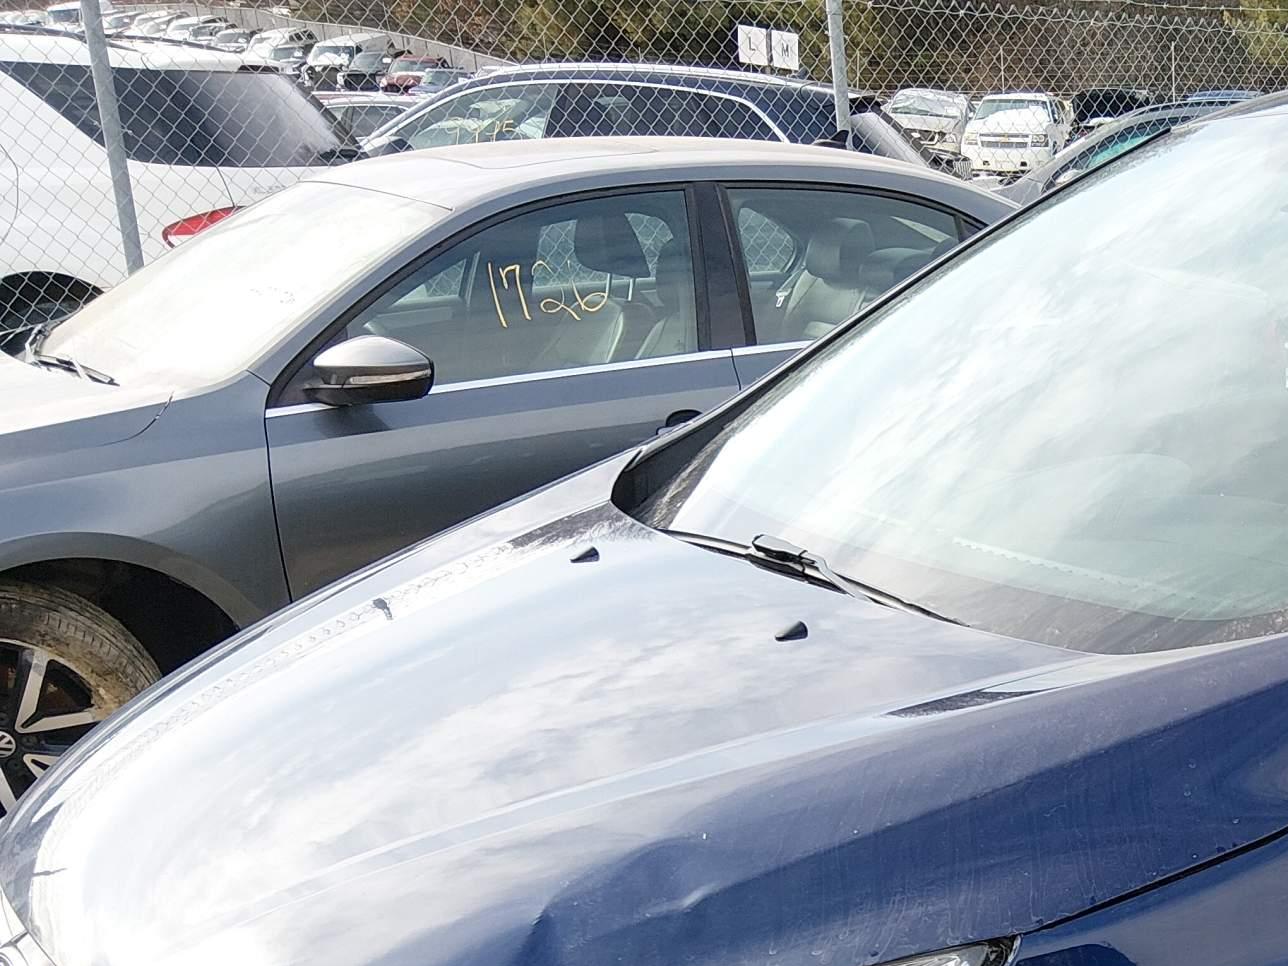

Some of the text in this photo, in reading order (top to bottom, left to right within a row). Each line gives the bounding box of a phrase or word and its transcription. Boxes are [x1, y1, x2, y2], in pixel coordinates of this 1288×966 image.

[748, 36, 757, 51] L
[781, 42, 790, 57] M
[488, 260, 610, 328] 1726
